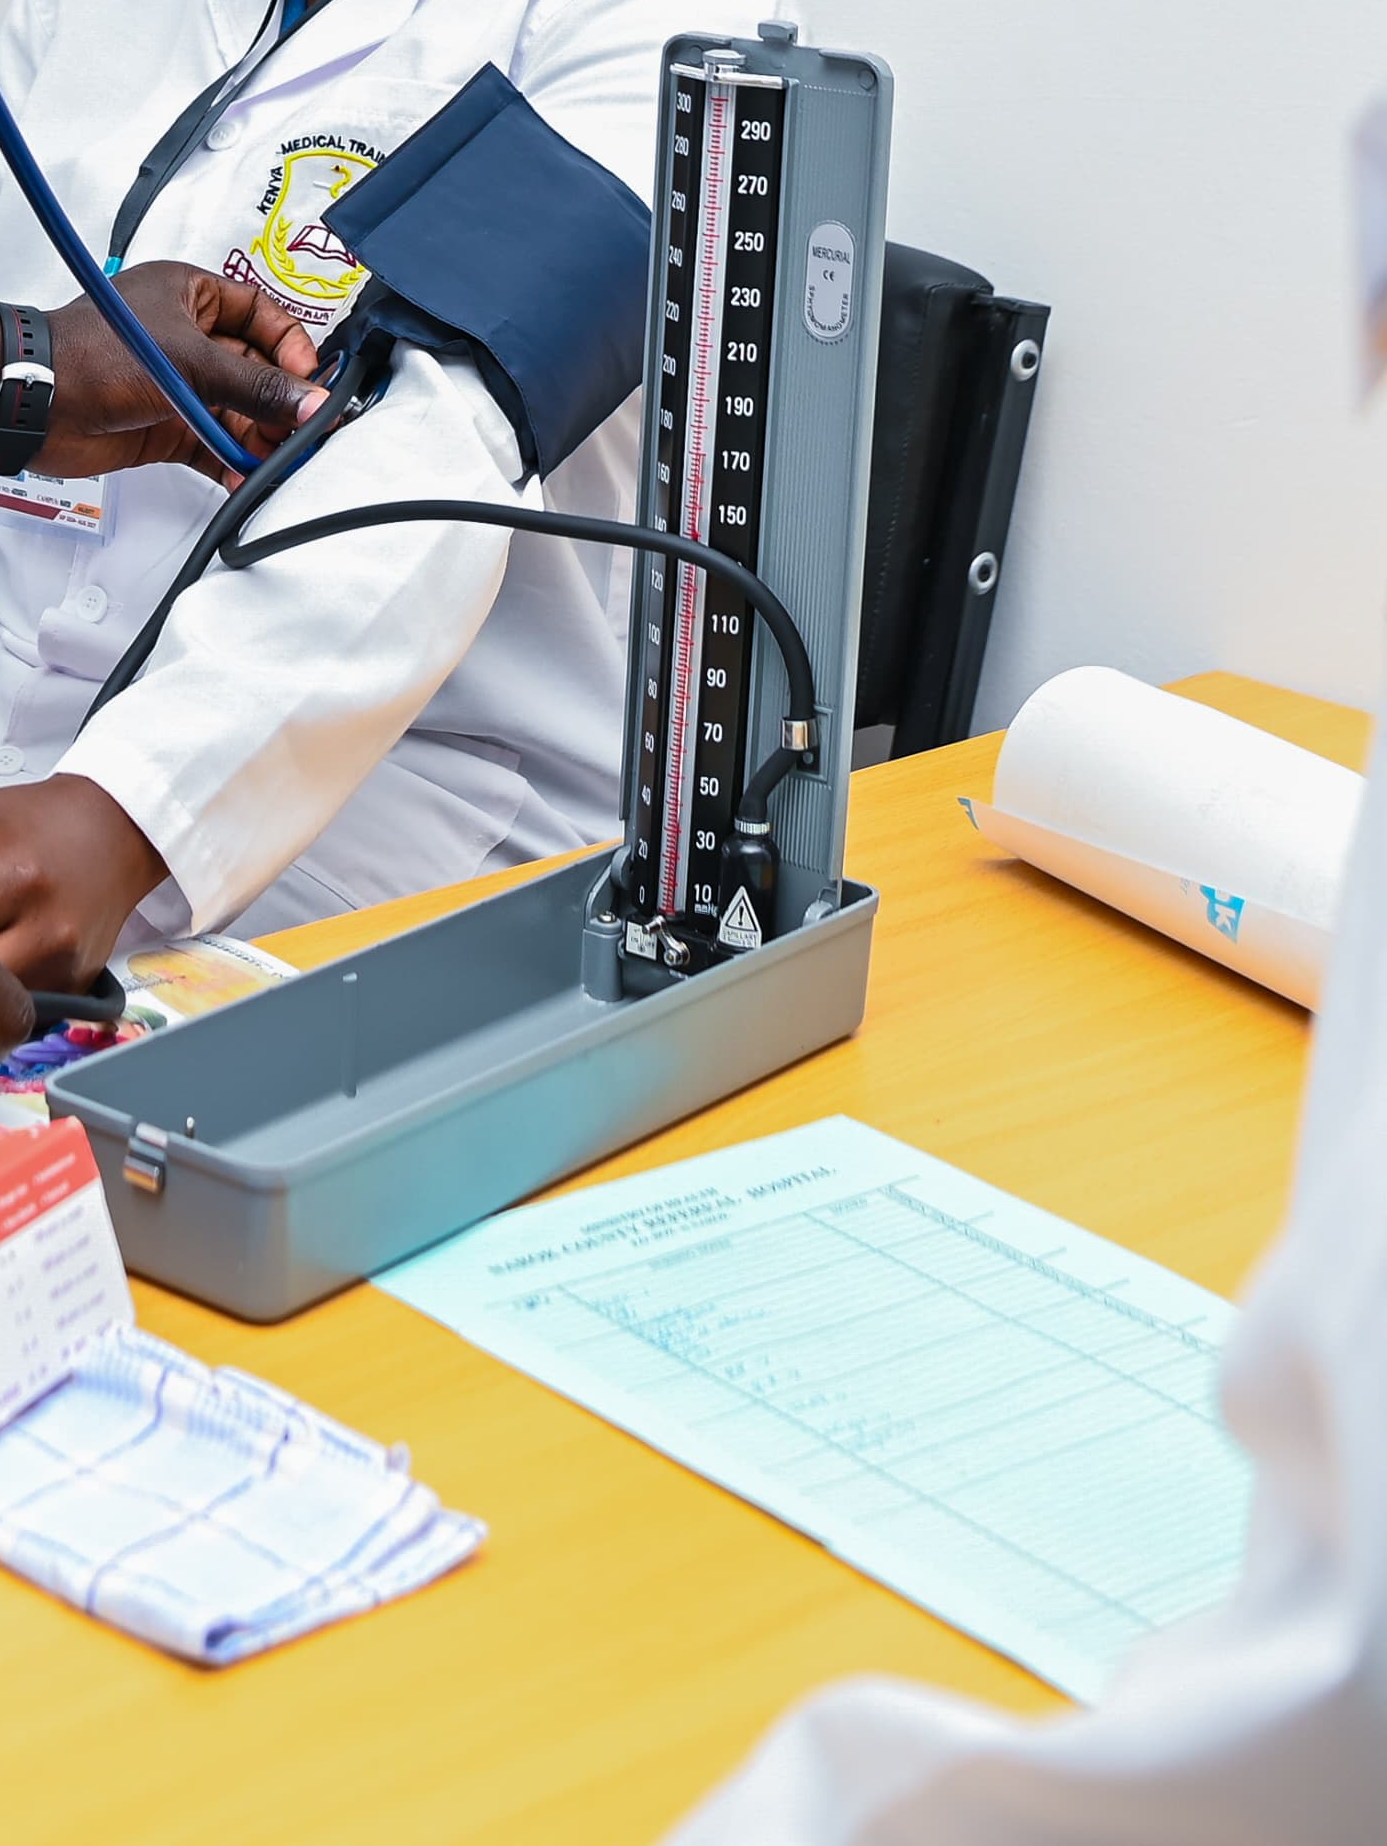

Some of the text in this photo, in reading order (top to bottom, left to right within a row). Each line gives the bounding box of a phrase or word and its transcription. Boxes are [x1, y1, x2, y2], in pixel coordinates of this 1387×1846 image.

[676, 91, 691, 114] 300
[740, 120, 771, 141] 290
[674, 134, 689, 157] 280
[257, 166, 283, 215] KENYA
[281, 135, 345, 154] MEDICAL
[737, 174, 768, 196] 270
[671, 190, 686, 213] 260
[733, 230, 764, 252] 250
[668, 245, 683, 268] 240
[730, 286, 761, 308] 230
[665, 299, 679, 323] 220
[727, 341, 758, 363] 210
[662, 353, 677, 377] 200
[725, 395, 754, 417] 190
[659, 407, 674, 431] 180
[721, 450, 751, 472] 170
[657, 461, 671, 485] 160
[718, 504, 747, 526] 150
[650, 568, 664, 593] 120
[647, 621, 661, 646] 100
[711, 614, 740, 635] 110
[647, 677, 658, 700] 80
[706, 667, 727, 688] 90
[644, 731, 655, 753] 60
[703, 721, 723, 743] 70
[640, 784, 651, 807] 40
[699, 776, 719, 797] 50
[638, 837, 648, 860] 20
[695, 830, 716, 851] 30
[639, 885, 645, 904] 0
[694, 883, 712, 904] 10
